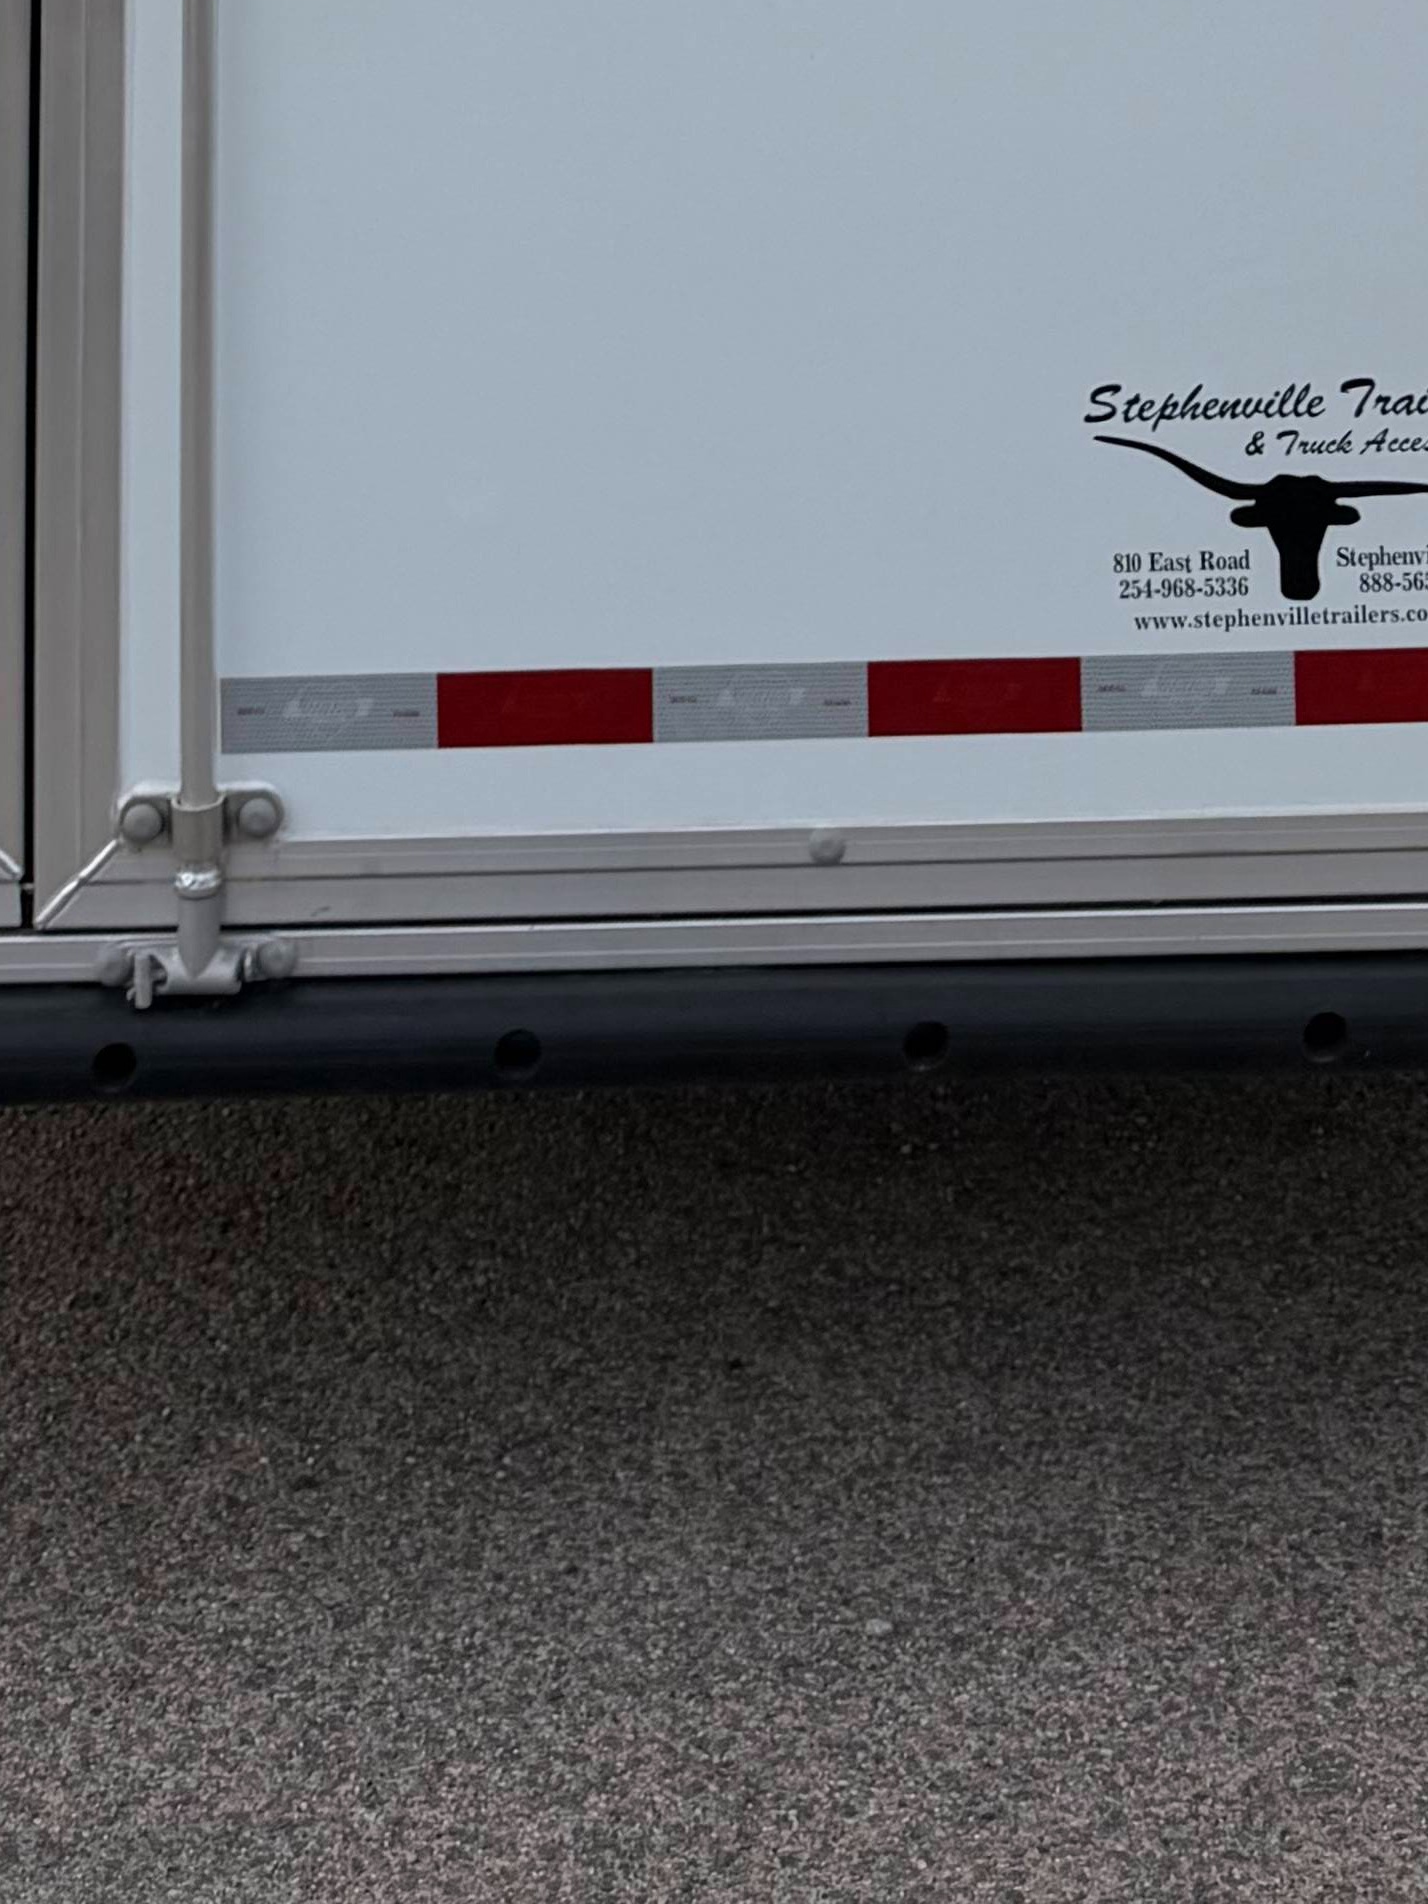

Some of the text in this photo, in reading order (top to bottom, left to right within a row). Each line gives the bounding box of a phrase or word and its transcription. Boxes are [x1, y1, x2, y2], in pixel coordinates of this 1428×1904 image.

[1083, 383, 1326, 433] Stephenville
[1244, 430, 1266, 457] &
[1276, 429, 1354, 457] Truck
[1113, 548, 1251, 574] 810 East Road
[1118, 575, 1250, 600] 254-968-5336
